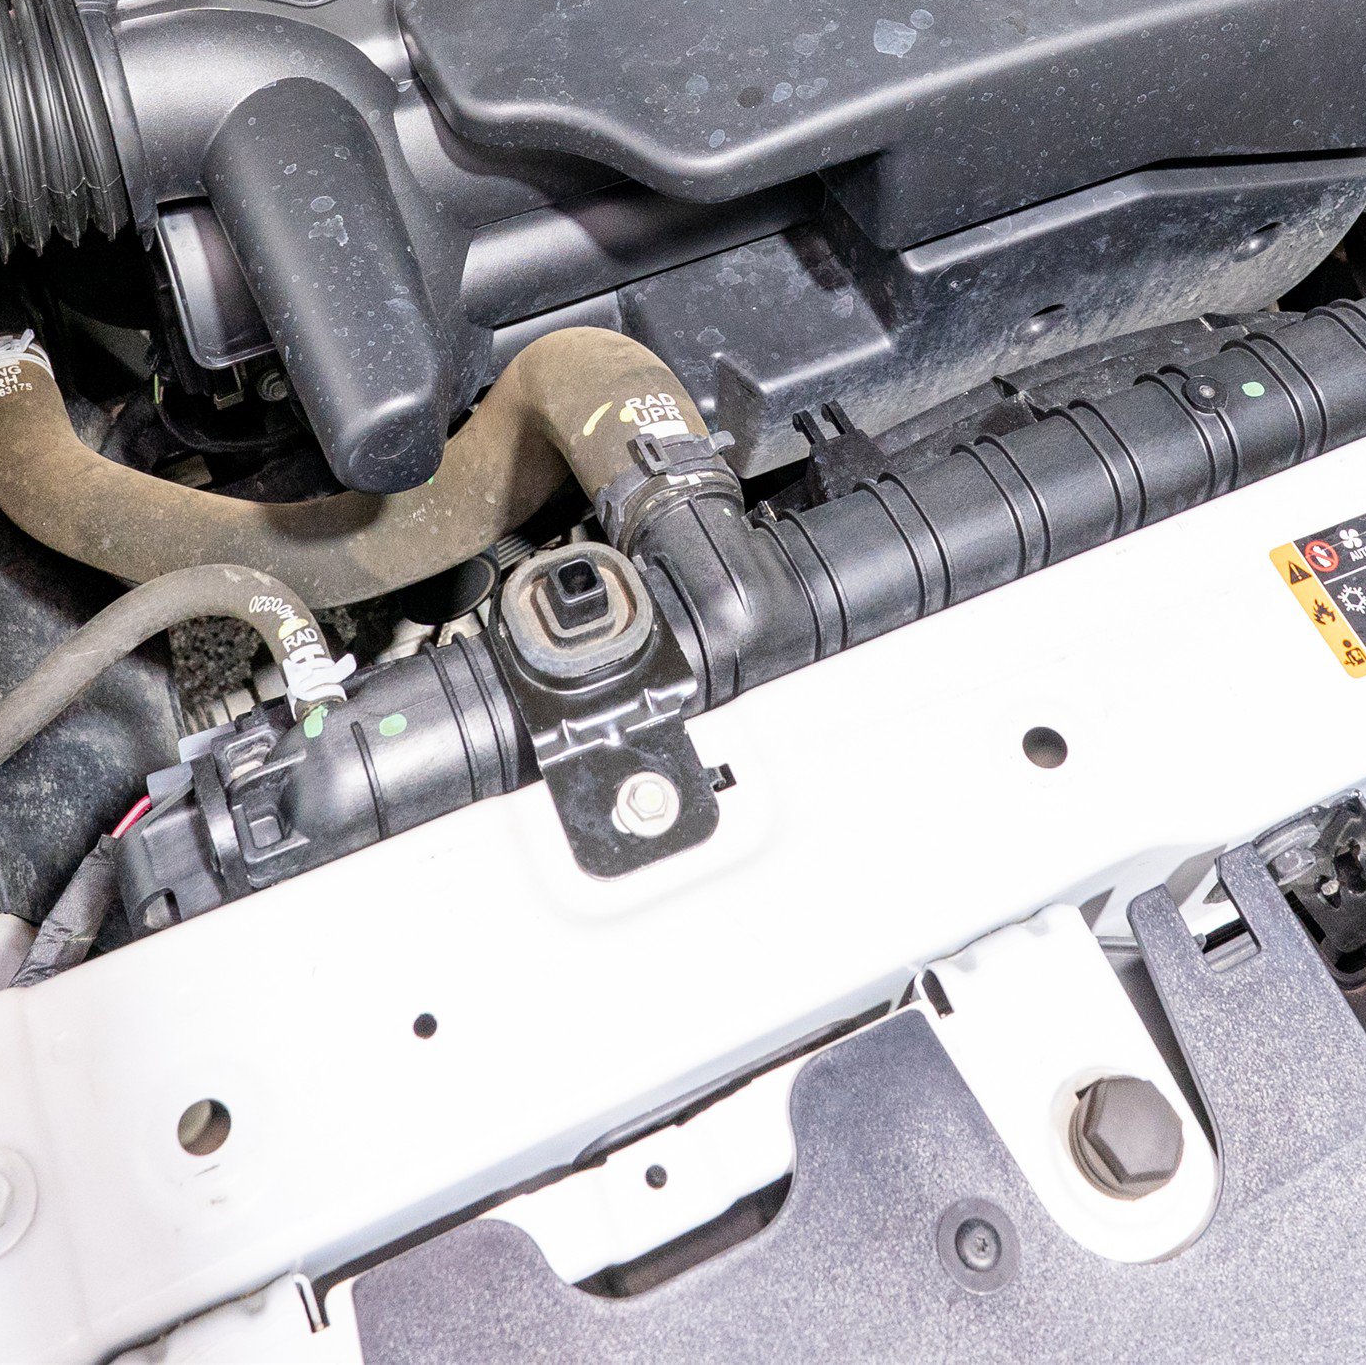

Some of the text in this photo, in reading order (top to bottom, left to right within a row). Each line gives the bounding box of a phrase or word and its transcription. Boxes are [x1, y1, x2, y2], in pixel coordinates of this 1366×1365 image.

[625, 392, 676, 409] RAD
[633, 406, 684, 426] UPR
[282, 628, 318, 652] RAD
